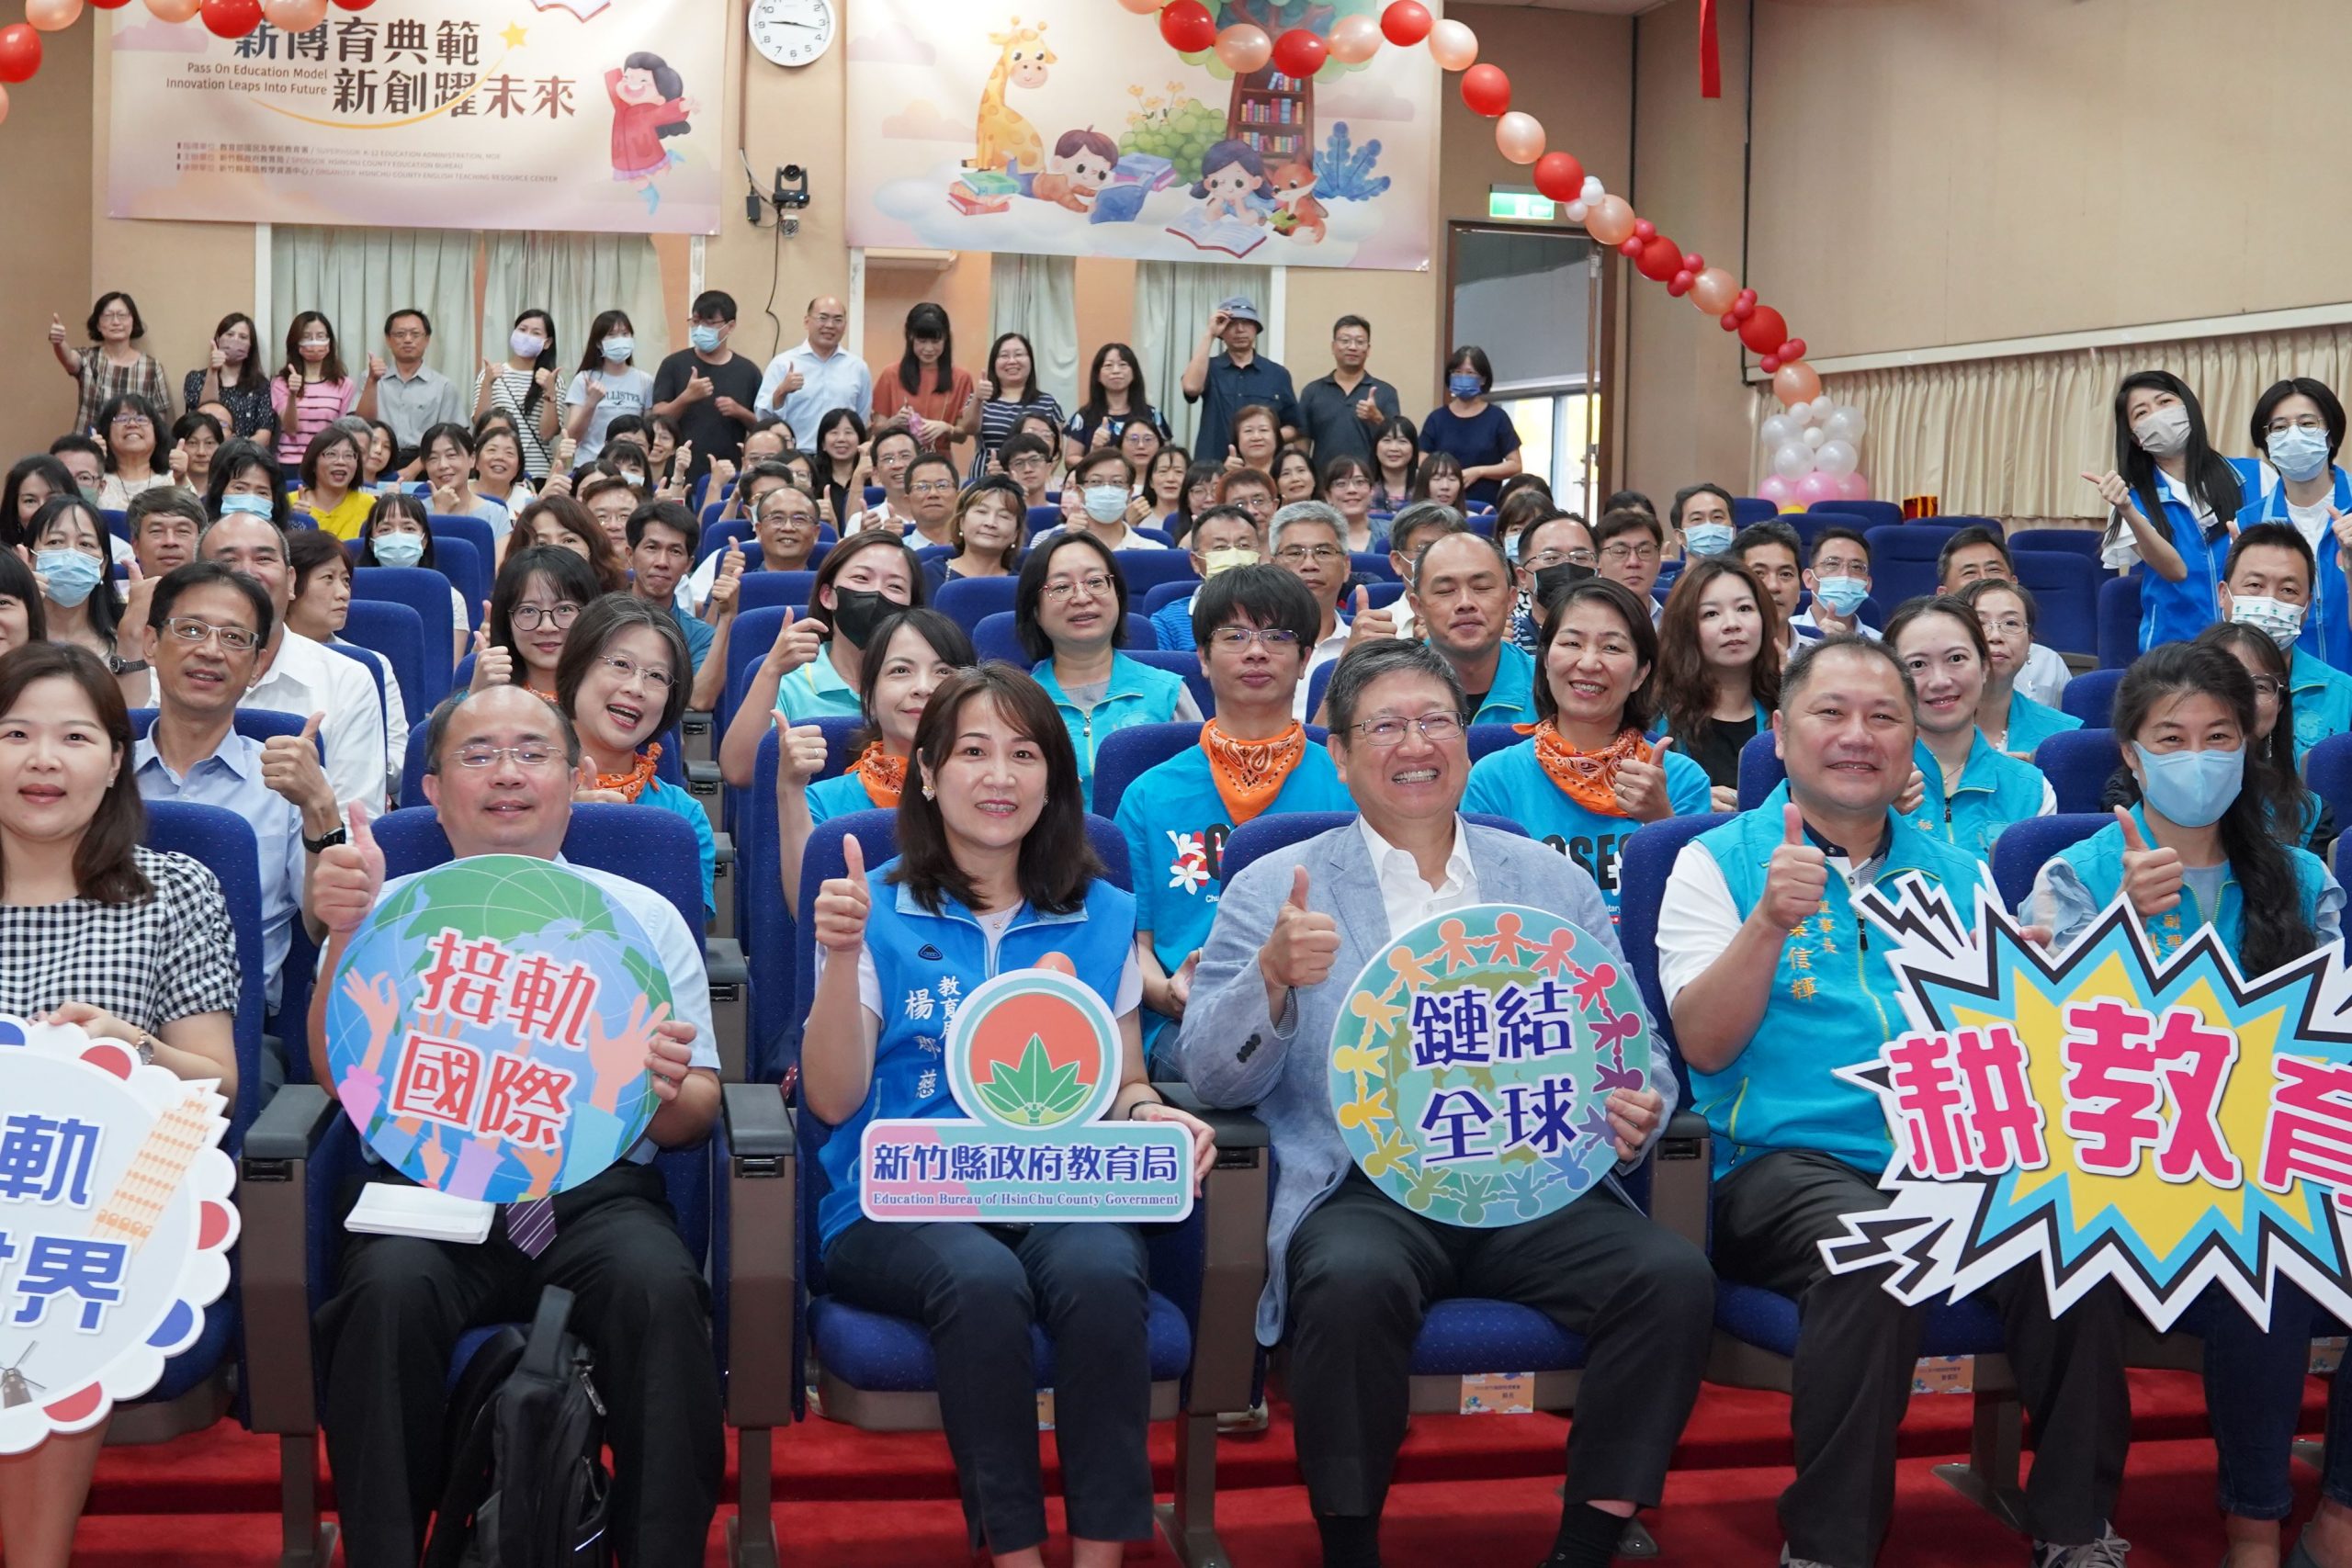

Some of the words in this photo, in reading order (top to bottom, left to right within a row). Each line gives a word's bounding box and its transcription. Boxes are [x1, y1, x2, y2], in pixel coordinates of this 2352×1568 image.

[166, 78, 225, 89] Innovation
[229, 80, 261, 93] Leaps
[265, 82, 288, 93] Into
[290, 85, 328, 95] Future
[187, 62, 211, 73] Pass
[215, 63, 231, 74] On
[233, 64, 289, 77] Education
[293, 68, 328, 79] Model
[333, 68, 576, 118] 新創躍未來
[420, 931, 597, 1047] 接軌
[1412, 981, 1573, 1066] 鏈結
[393, 1034, 571, 1147] 國際
[1421, 1077, 1578, 1164] 全球
[873, 1145, 1178, 1182] 新竹縣政府教育局
[874, 1192, 934, 1205] Education
[939, 1192, 981, 1205] Bureau
[986, 1192, 997, 1205] of
[1001, 1192, 1053, 1205] HsinChu
[1057, 1192, 1101, 1207] County
[1105, 1192, 1179, 1205] Government
[0, 1232, 127, 1329] 界
